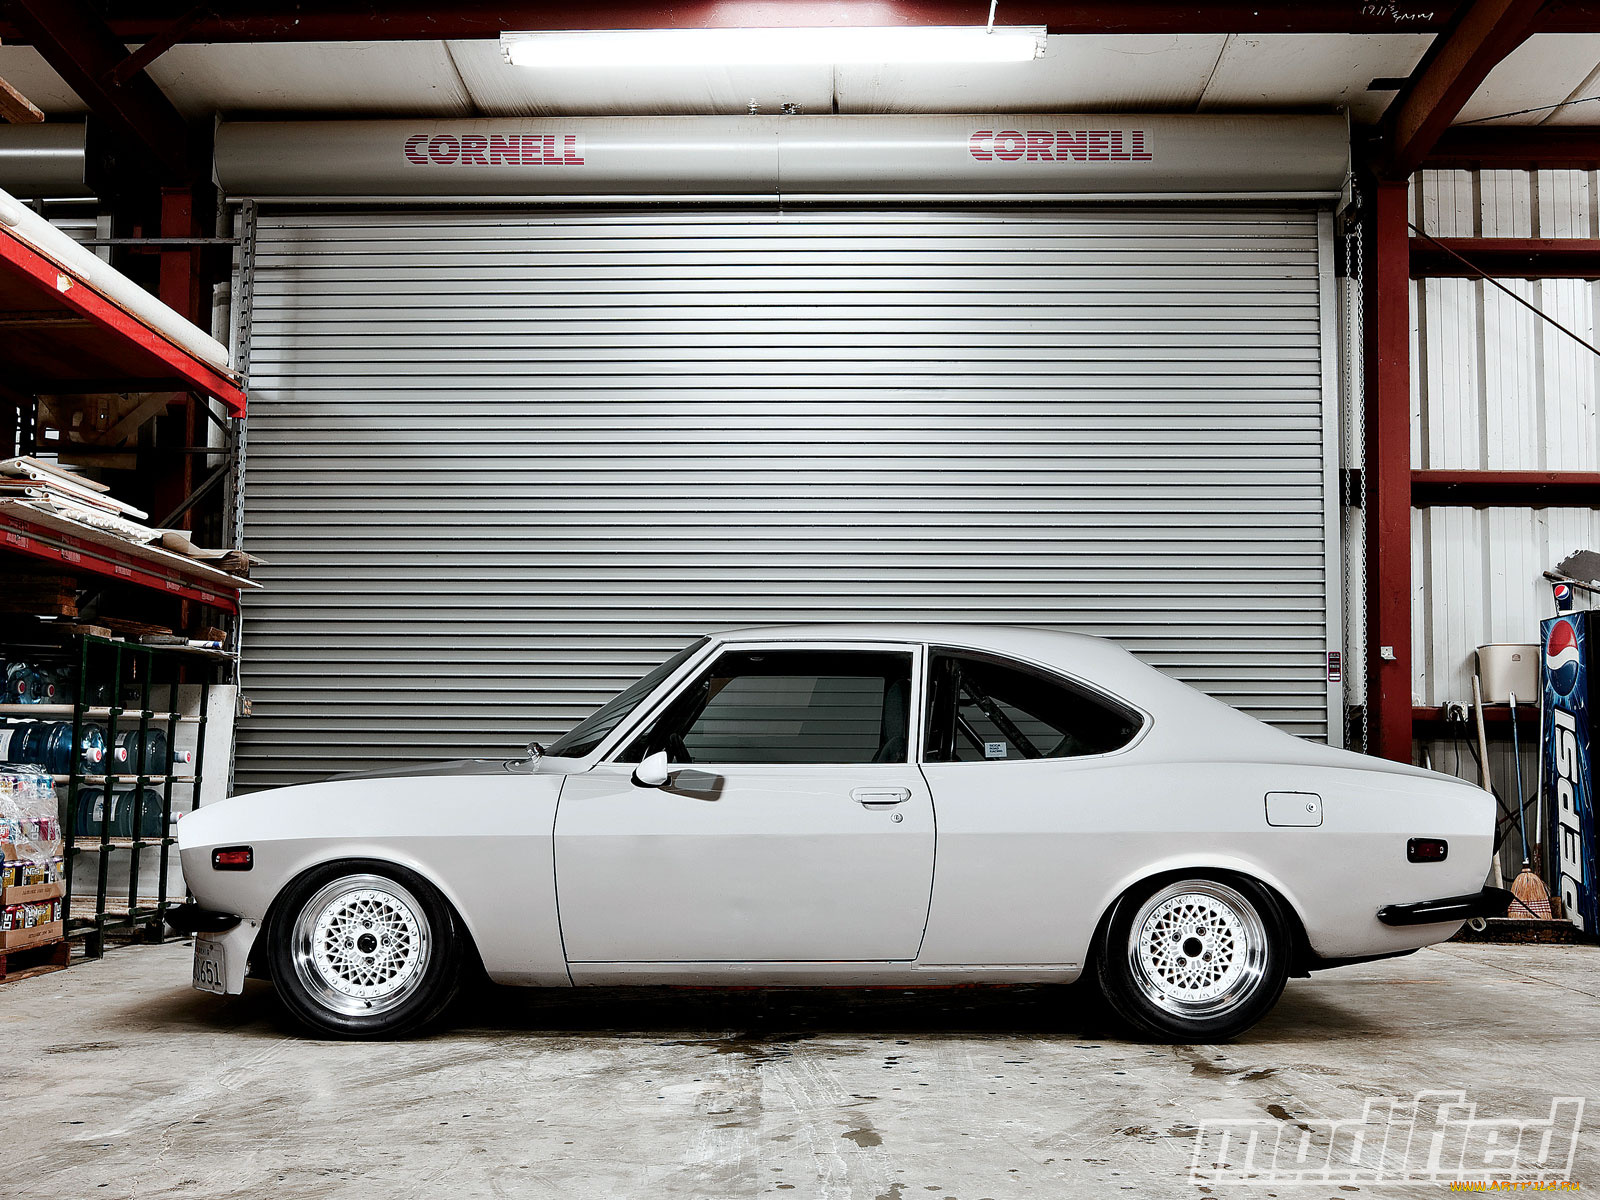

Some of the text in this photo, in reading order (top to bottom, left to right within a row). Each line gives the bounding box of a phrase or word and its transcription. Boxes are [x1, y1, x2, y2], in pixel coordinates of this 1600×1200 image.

[404, 134, 585, 166] CORNELL
[969, 130, 1153, 161] CORNELL
[1554, 708, 1585, 932] PEPSI
